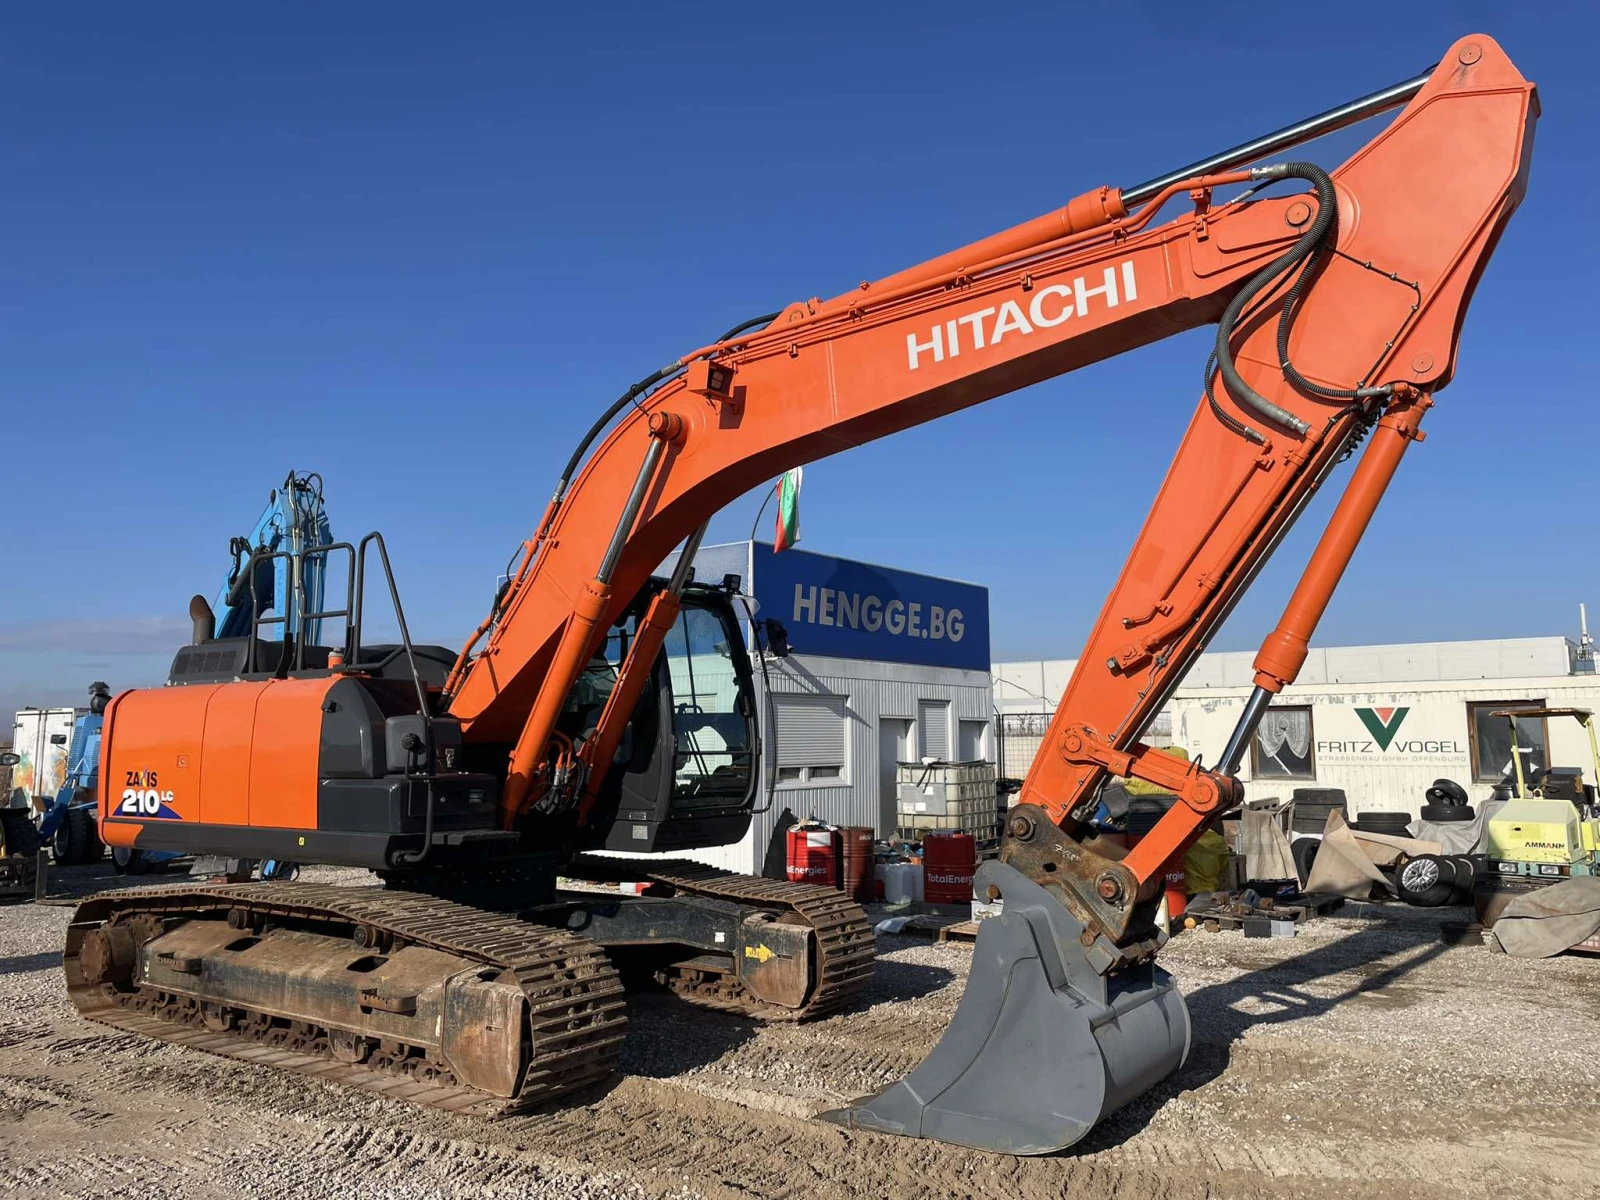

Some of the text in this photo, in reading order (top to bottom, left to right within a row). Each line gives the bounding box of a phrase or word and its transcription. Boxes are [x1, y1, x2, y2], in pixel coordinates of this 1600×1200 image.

[906, 260, 1137, 371] HITACHI
[793, 583, 965, 642] HENGGE.BG
[1317, 741, 1465, 753] FRITZ VOGEL
[126, 769, 157, 787] ZAXIS
[122, 789, 174, 816] 210 LC
[1525, 841, 1565, 849] AMMANN
[927, 873, 974, 885] TotalEnerg
